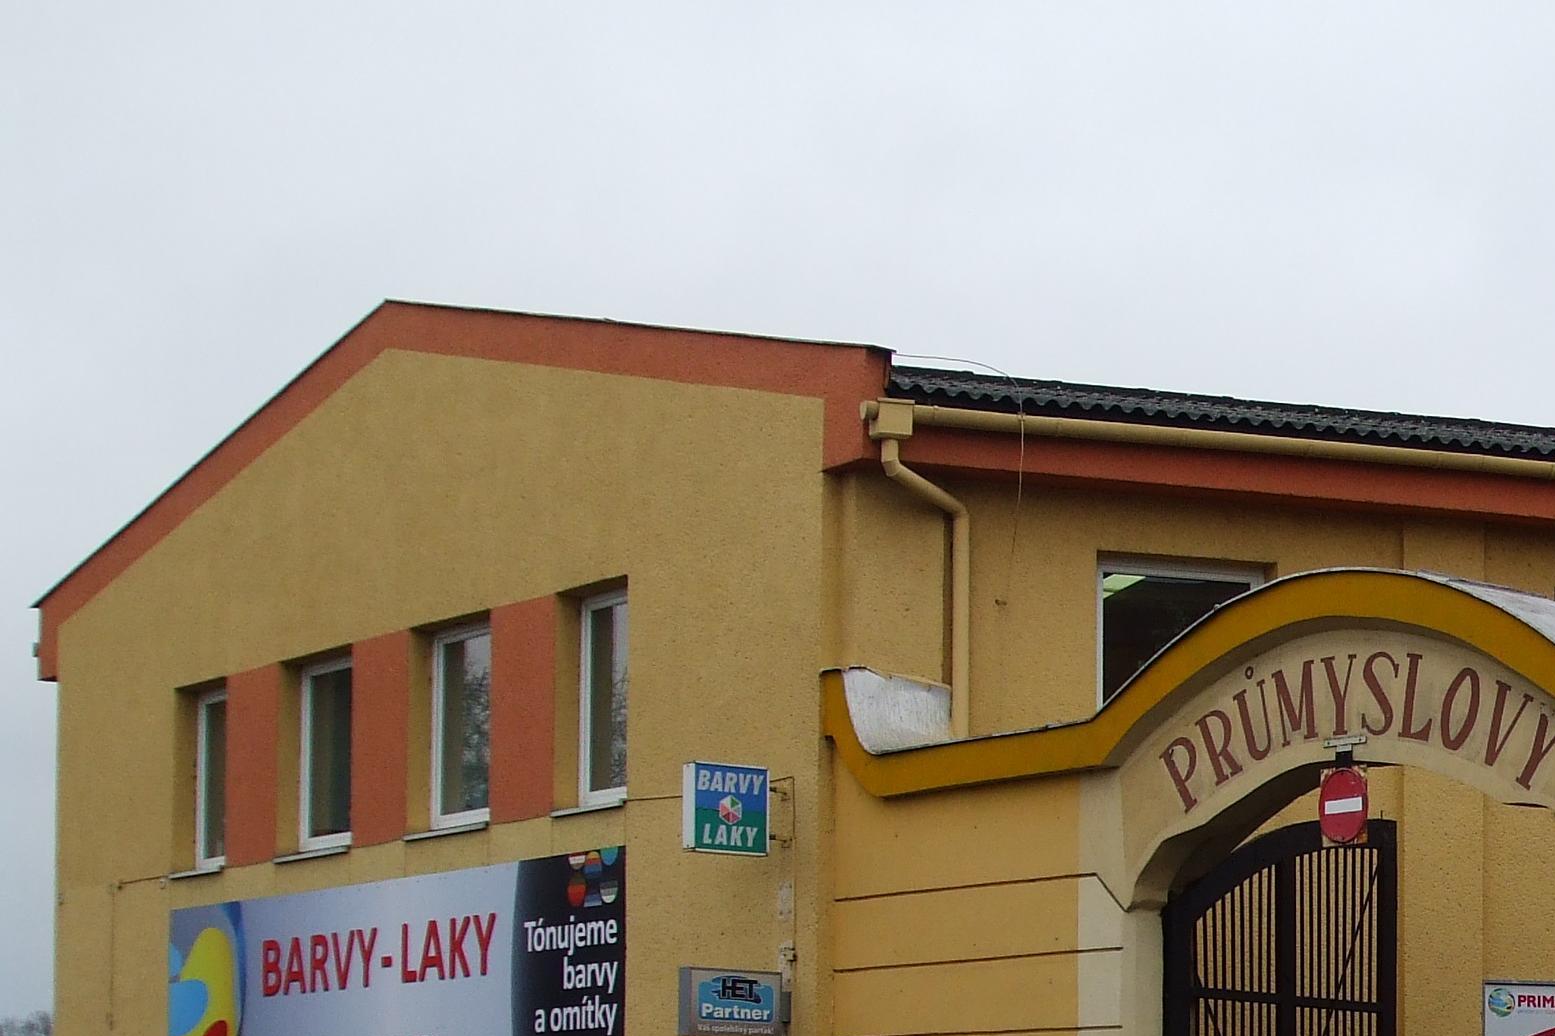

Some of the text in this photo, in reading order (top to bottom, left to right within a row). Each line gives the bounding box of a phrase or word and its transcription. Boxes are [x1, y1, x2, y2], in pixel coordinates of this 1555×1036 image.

[697, 769, 764, 796] BARVY
[703, 823, 758, 848] LAKY
[524, 915, 618, 956] Tónujeme
[562, 956, 618, 994] barvy
[721, 977, 758, 1000] HET
[534, 995, 618, 1036] a omítky
[701, 1003, 771, 1021] Partner
